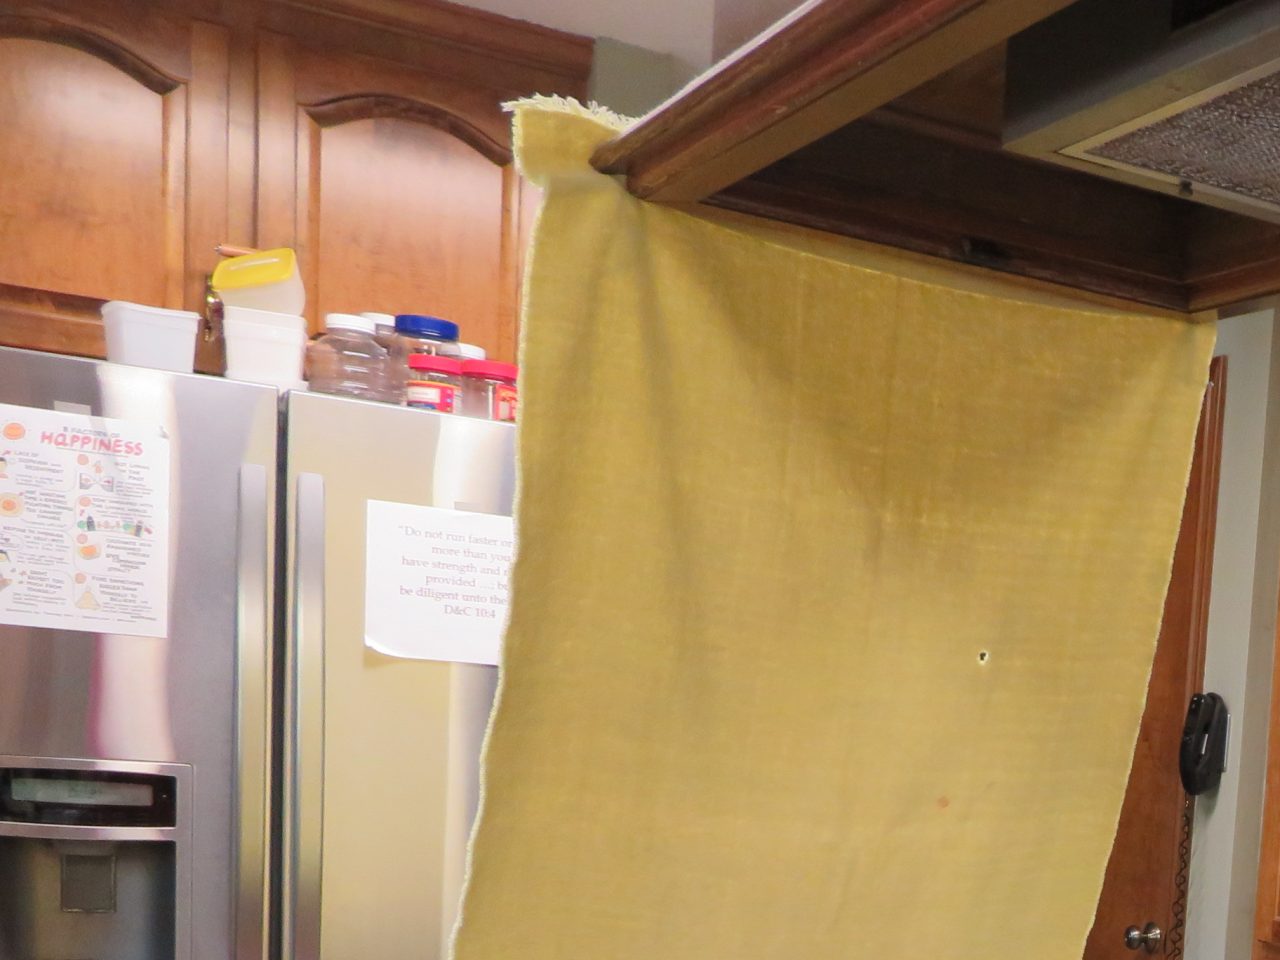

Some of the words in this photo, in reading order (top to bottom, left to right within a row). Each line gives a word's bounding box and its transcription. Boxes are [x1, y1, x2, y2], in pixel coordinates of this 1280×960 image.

[425, 530, 443, 540] not
[446, 532, 465, 542] run
[469, 535, 498, 546] faster
[431, 545, 460, 556] more
[463, 548, 488, 560] than
[491, 553, 511, 564] you
[401, 555, 429, 568] have
[432, 560, 477, 575] strength
[480, 565, 500, 577] and
[425, 575, 476, 588] provided
[399, 585, 413, 596] be
[416, 587, 459, 602] diligent
[462, 593, 488, 604] unto
[490, 594, 507, 606] the
[444, 604, 471, 617] D&C
[475, 606, 496, 619] 10:4
